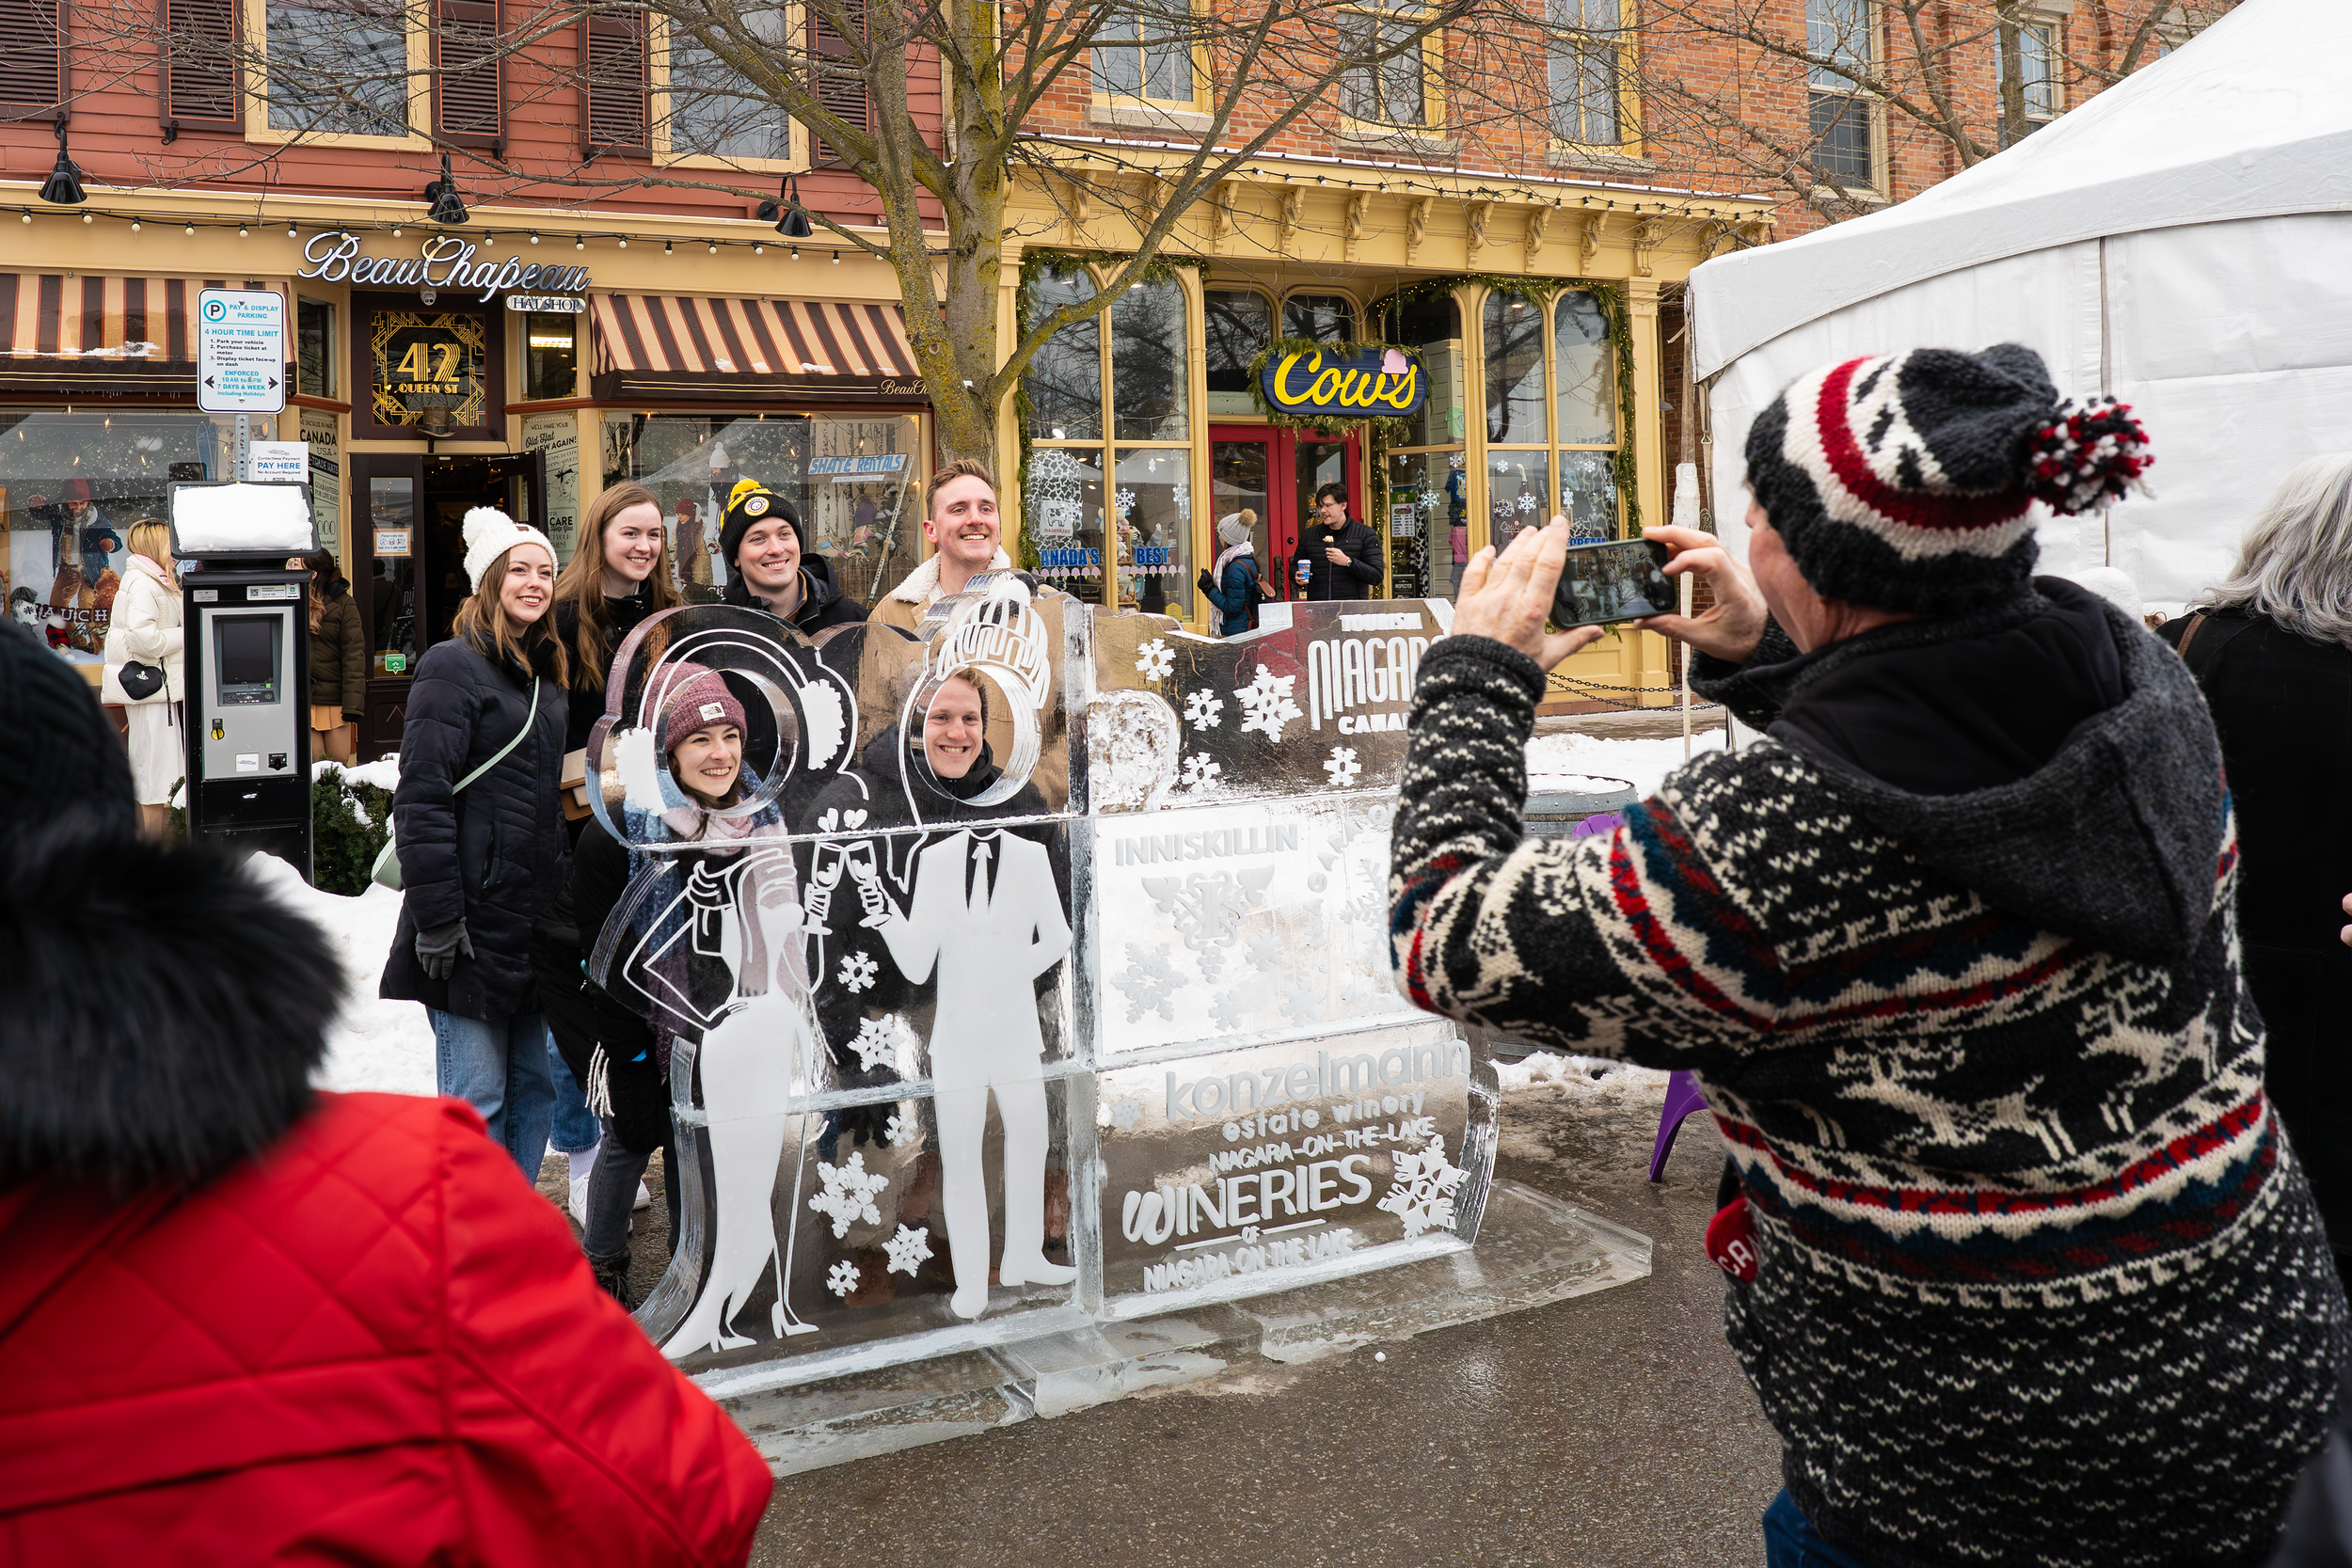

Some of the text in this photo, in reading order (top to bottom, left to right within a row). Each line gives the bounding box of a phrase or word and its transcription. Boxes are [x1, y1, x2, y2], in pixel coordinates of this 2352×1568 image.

[210, 305, 220, 316] P
[514, 297, 580, 311] HAT SHOP
[396, 342, 461, 382] 42
[1274, 347, 1418, 409] Cows
[444, 384, 458, 394] ST
[881, 379, 930, 395] BeauCh
[300, 429, 337, 446] CANADA
[526, 431, 555, 448] Old Hat
[551, 436, 577, 450] AGAIN!
[316, 447, 332, 455] USA
[857, 454, 901, 472] RENTALS
[549, 516, 573, 526] CARE
[1041, 546, 1169, 567] ANADA'S BEST
[1115, 824, 1298, 866] INNISKILLIN
[1166, 1039, 1470, 1122] konzelmann
[1222, 1091, 1425, 1142] estate winery
[1208, 1117, 1438, 1174] NIAGARA-ON-THE-LAKE
[1121, 1154, 1373, 1245] WINERIES
[1241, 1226, 1260, 1243] OF
